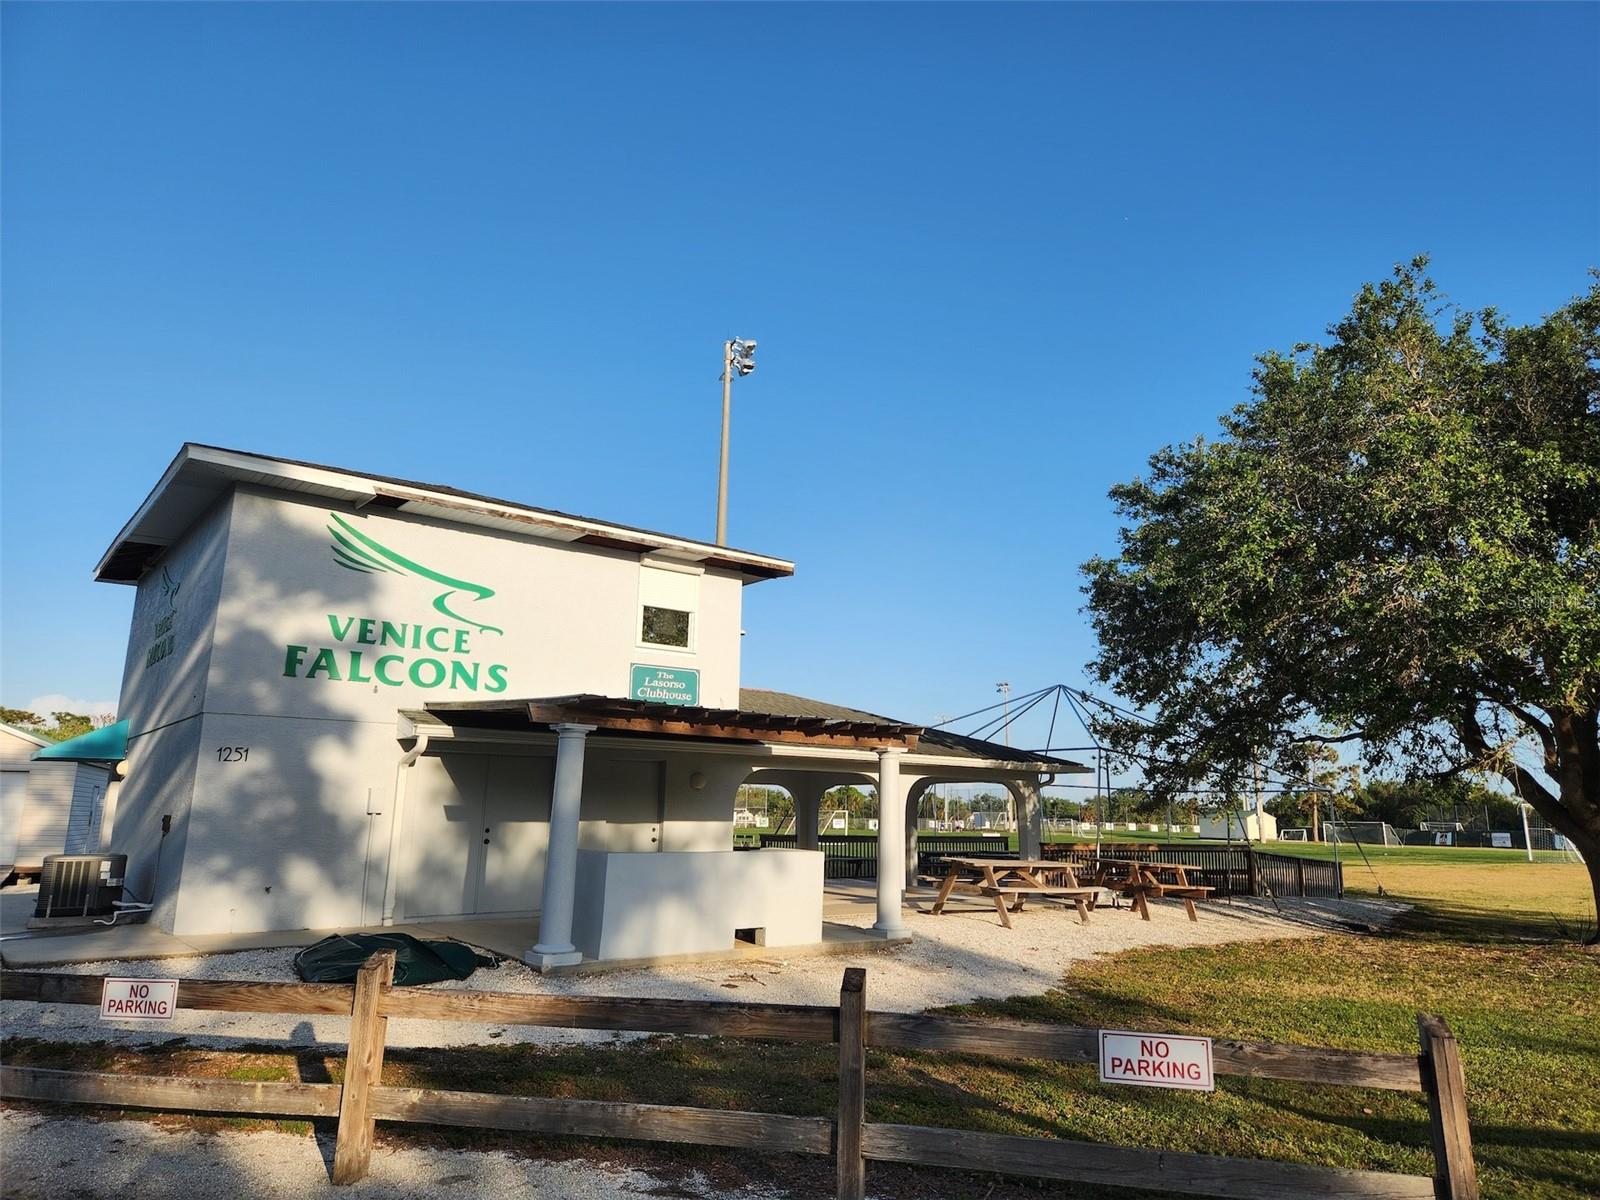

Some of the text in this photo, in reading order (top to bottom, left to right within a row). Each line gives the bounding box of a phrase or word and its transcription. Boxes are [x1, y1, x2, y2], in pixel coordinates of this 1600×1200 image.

[327, 614, 471, 654] VENICE
[282, 644, 508, 693] FALCONS
[656, 671, 674, 680] The
[644, 677, 686, 689] Lasorso
[637, 687, 693, 701] Clubhouse
[216, 746, 249, 762] 1251
[129, 984, 150, 999] NO
[107, 999, 168, 1015] PARKING
[1140, 1039, 1170, 1058] NO
[1111, 1056, 1201, 1081] PARKING
